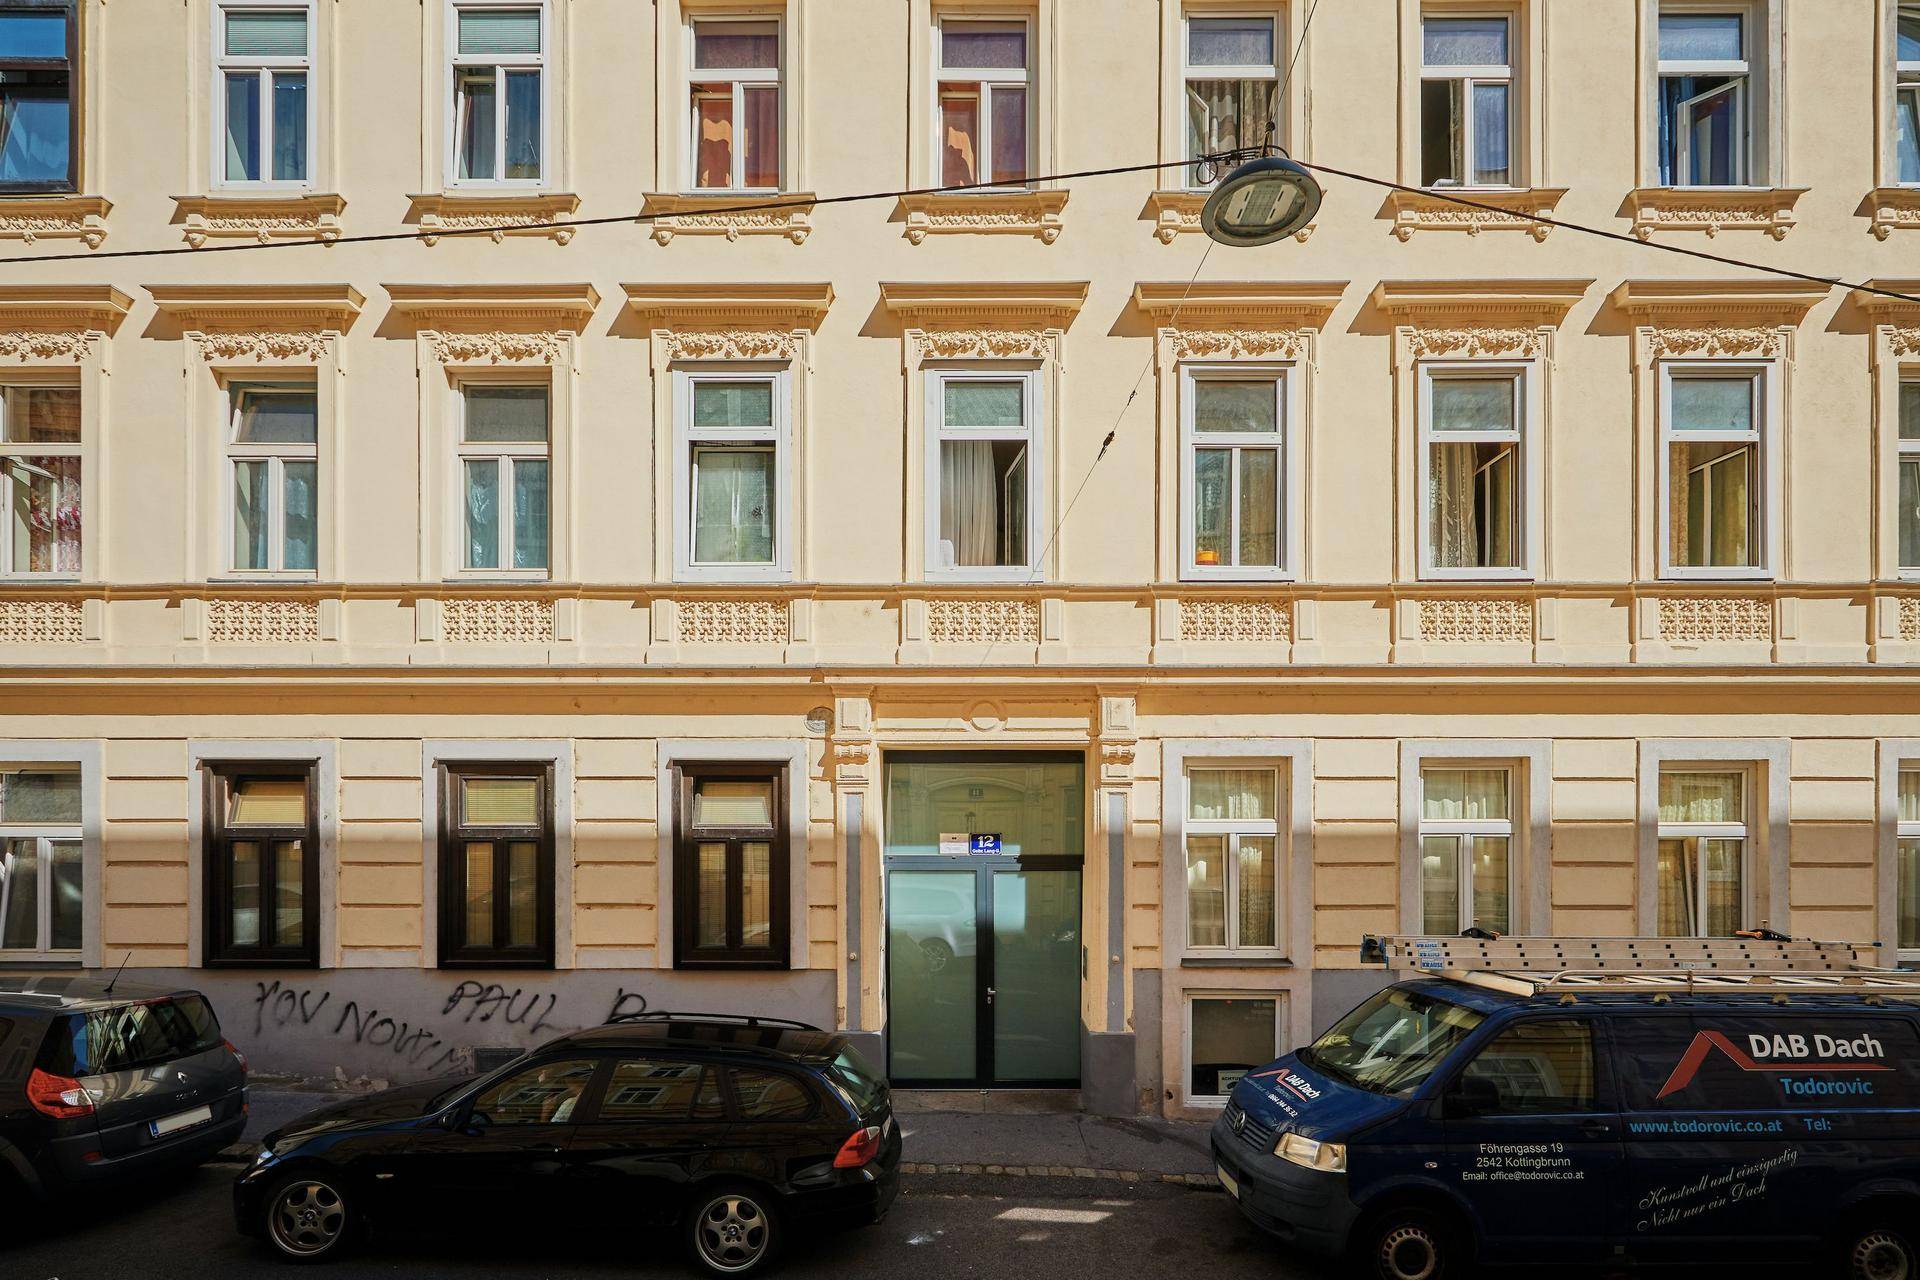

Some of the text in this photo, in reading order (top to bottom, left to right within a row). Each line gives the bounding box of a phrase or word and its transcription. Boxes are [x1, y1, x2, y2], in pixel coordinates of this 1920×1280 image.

[977, 835, 995, 848] 12
[442, 980, 557, 1034] PAUL
[1748, 1033, 1884, 1058] DAB Dach
[1284, 1074, 1321, 1099] DAB Dach
[1779, 1077, 1874, 1096] Todorovic
[1629, 1117, 1832, 1133] www.todorovic.co.at Tel:
[1479, 1142, 1564, 1156] Föhrengasse 19
[1476, 1156, 1571, 1170] 2542 Kottingbrunn
[1462, 1170, 1585, 1181] Email: office@todorovic.co.at
[1639, 1148, 1799, 1210] Kunstvoll und einzigartig
[1637, 1177, 1767, 1231] Nicht nur ein Dach
